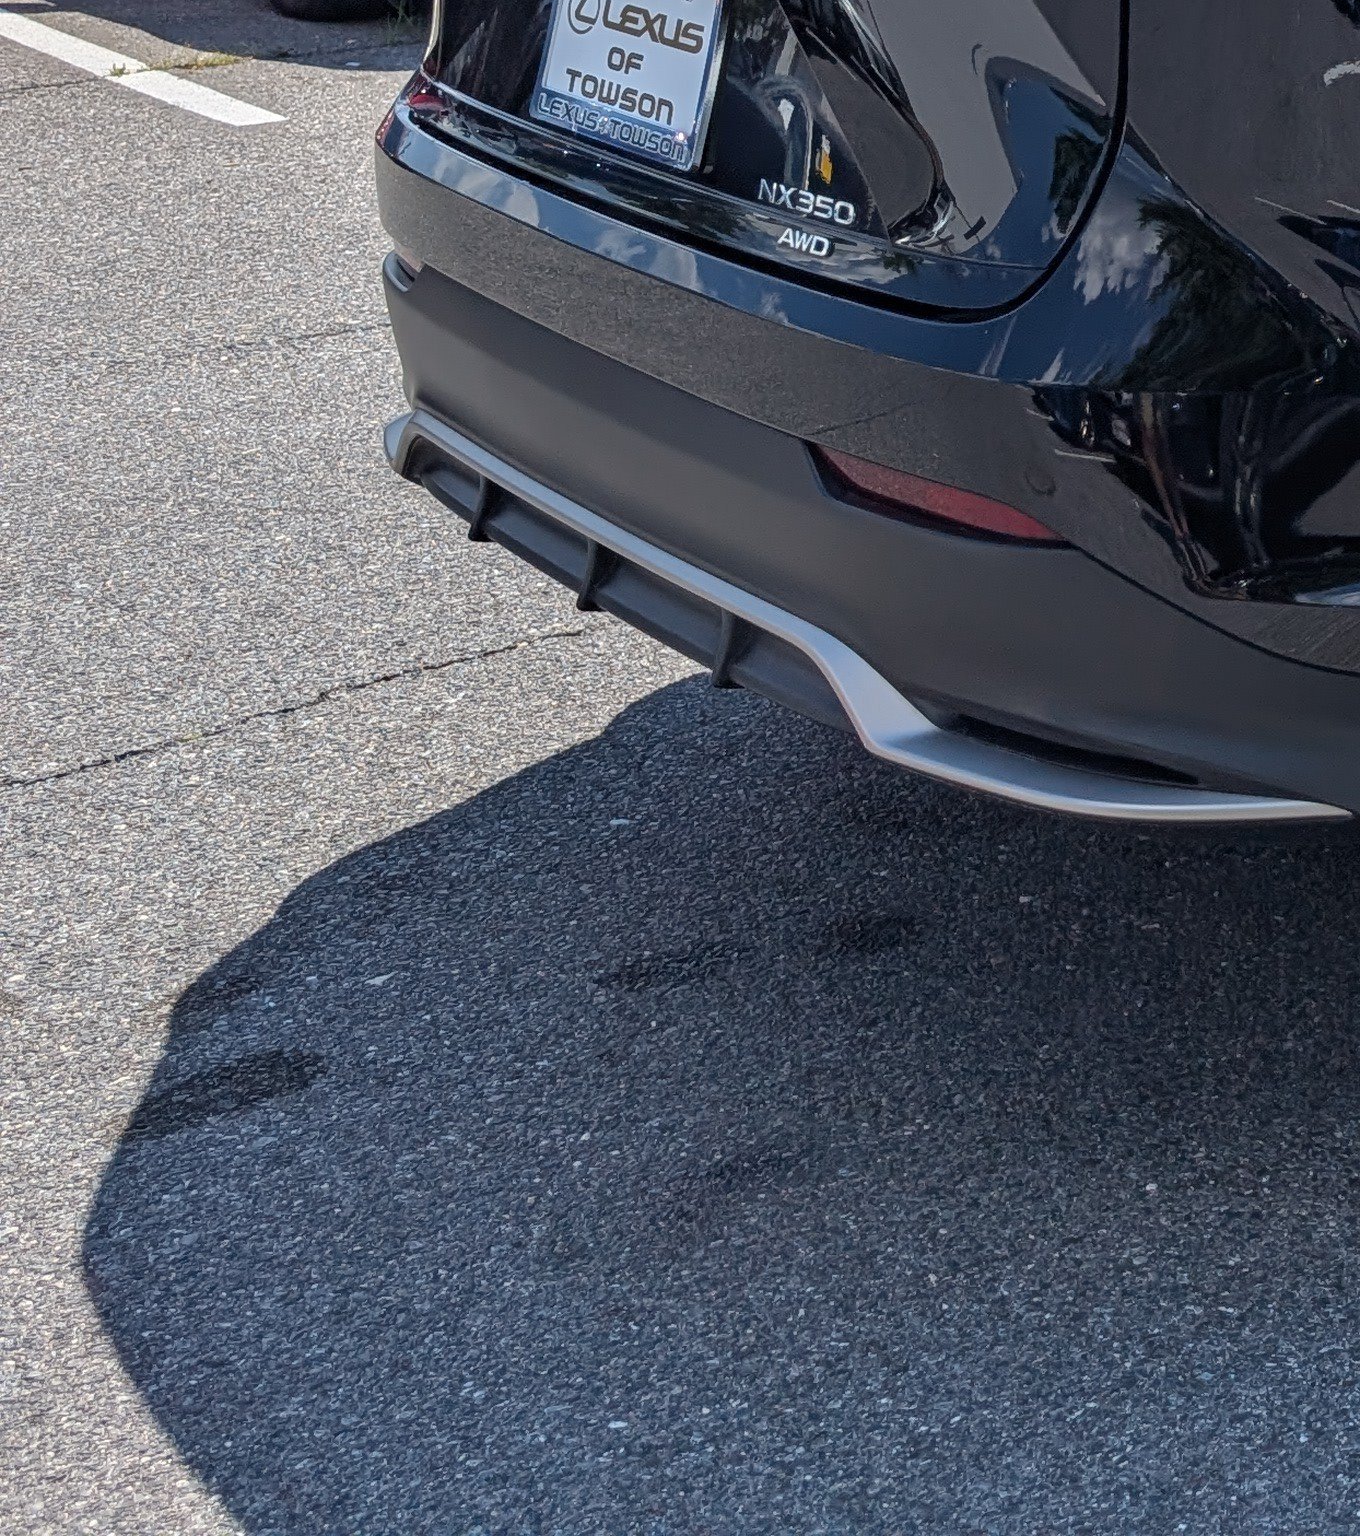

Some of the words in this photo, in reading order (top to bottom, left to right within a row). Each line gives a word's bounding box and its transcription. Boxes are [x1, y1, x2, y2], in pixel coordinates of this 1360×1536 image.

[607, 46, 644, 74] OF
[566, 67, 674, 126] TOWSON
[537, 92, 599, 129] LEXUS
[609, 117, 686, 163] TOWSON
[758, 178, 856, 225] NX350
[777, 228, 831, 257] AWD
